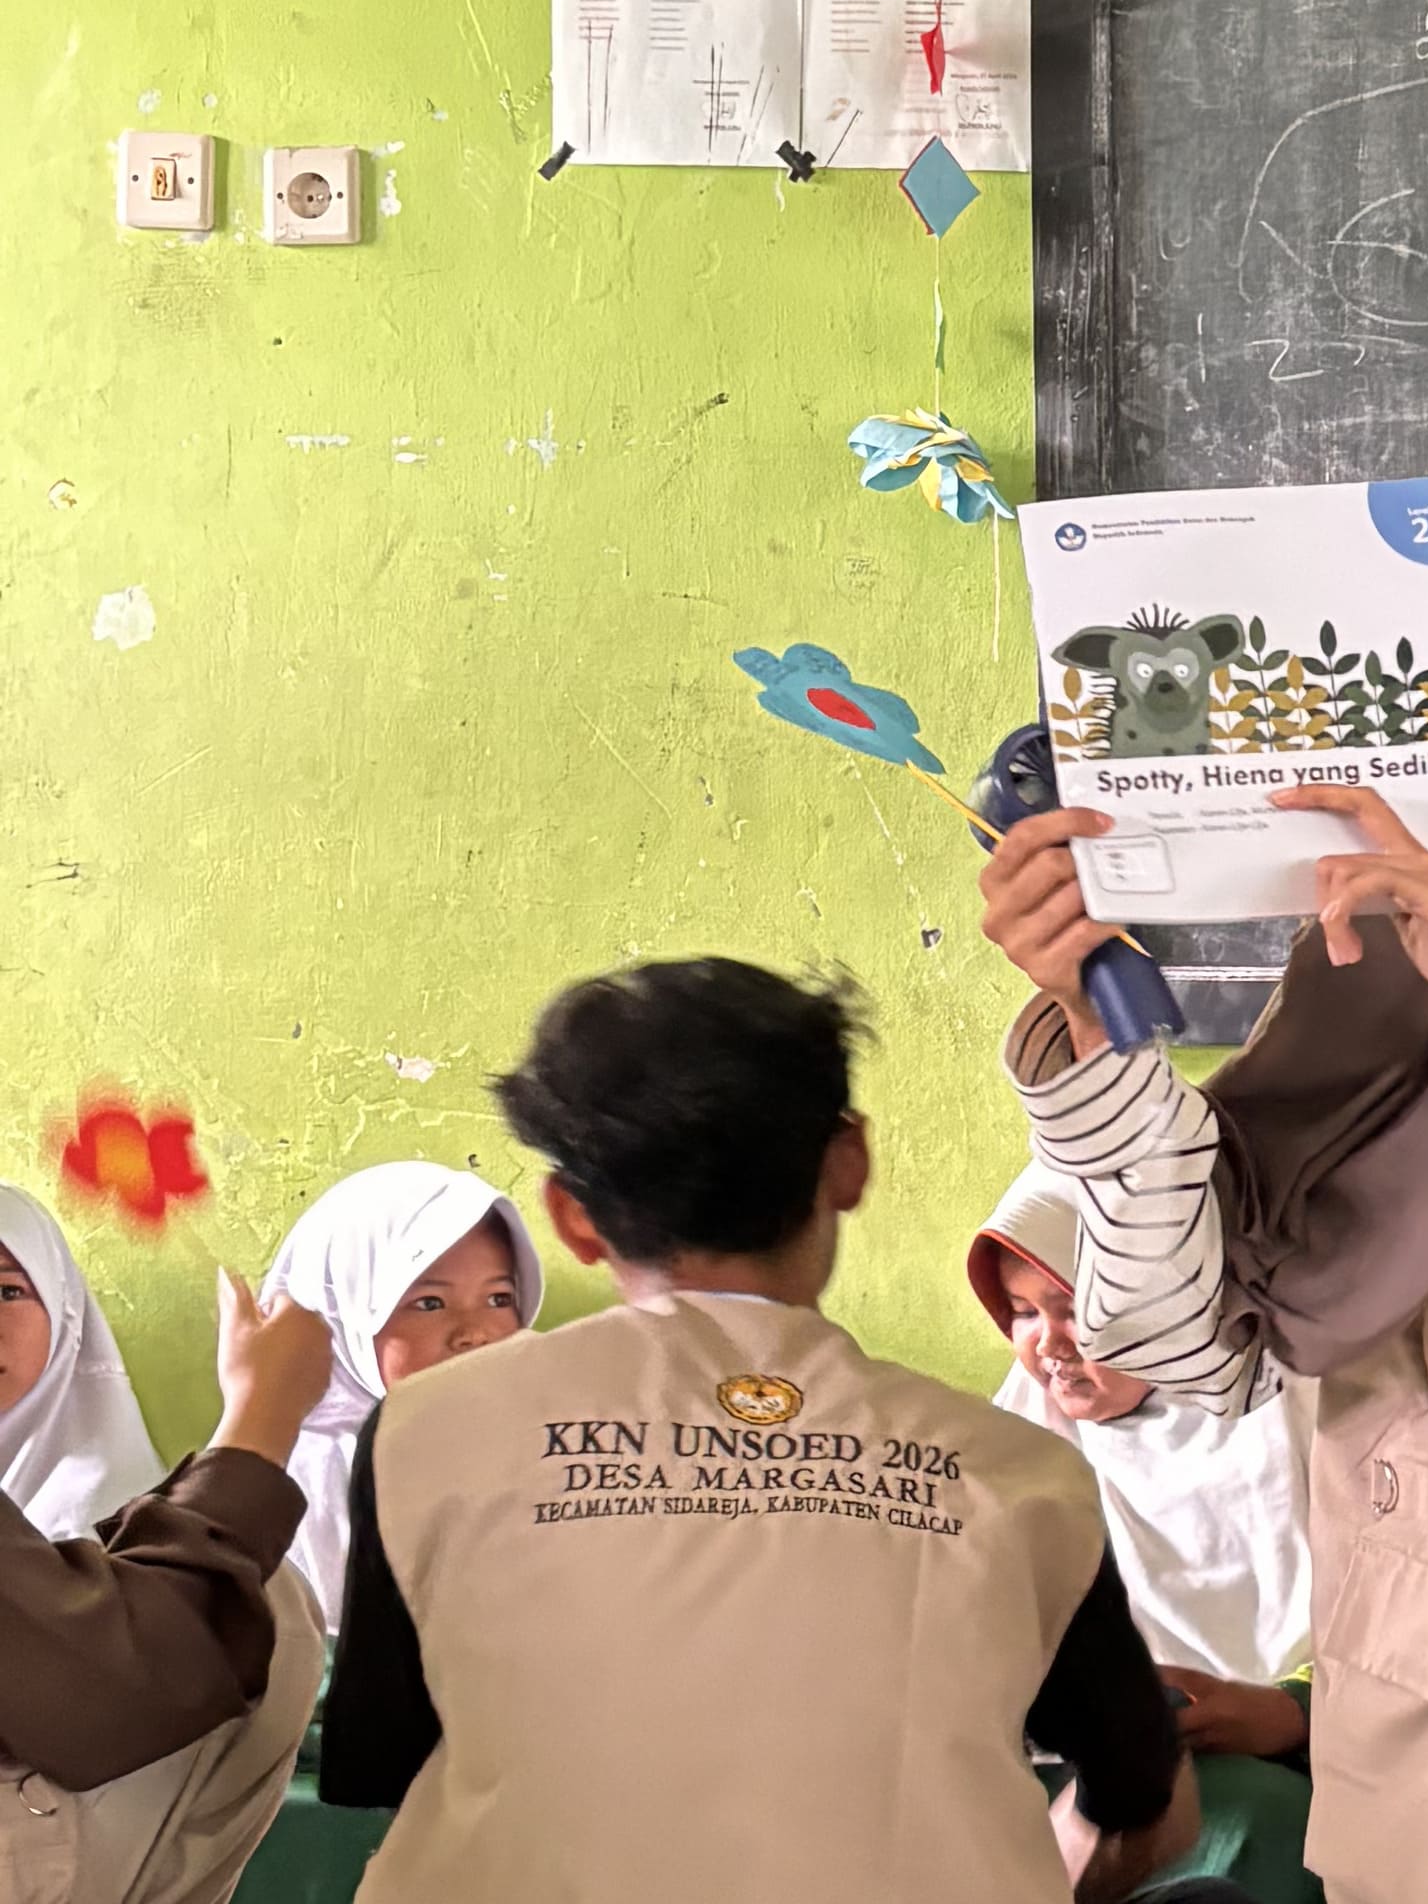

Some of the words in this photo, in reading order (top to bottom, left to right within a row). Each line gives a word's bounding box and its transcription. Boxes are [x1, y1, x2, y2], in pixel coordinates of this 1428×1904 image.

[1096, 769, 1194, 797] Spotty,
[1202, 765, 1284, 788] Hiena
[1293, 762, 1361, 785] yang
[541, 1421, 648, 1459] KKN
[671, 1422, 863, 1465] UNSOED
[882, 1438, 961, 1481] 2026
[563, 1463, 671, 1492] DESA
[692, 1467, 939, 1509] MARGASARI
[533, 1496, 655, 1525] KECAMATAN
[766, 1494, 882, 1522] KABUPATEN
[887, 1510, 964, 1537] CILACAP
